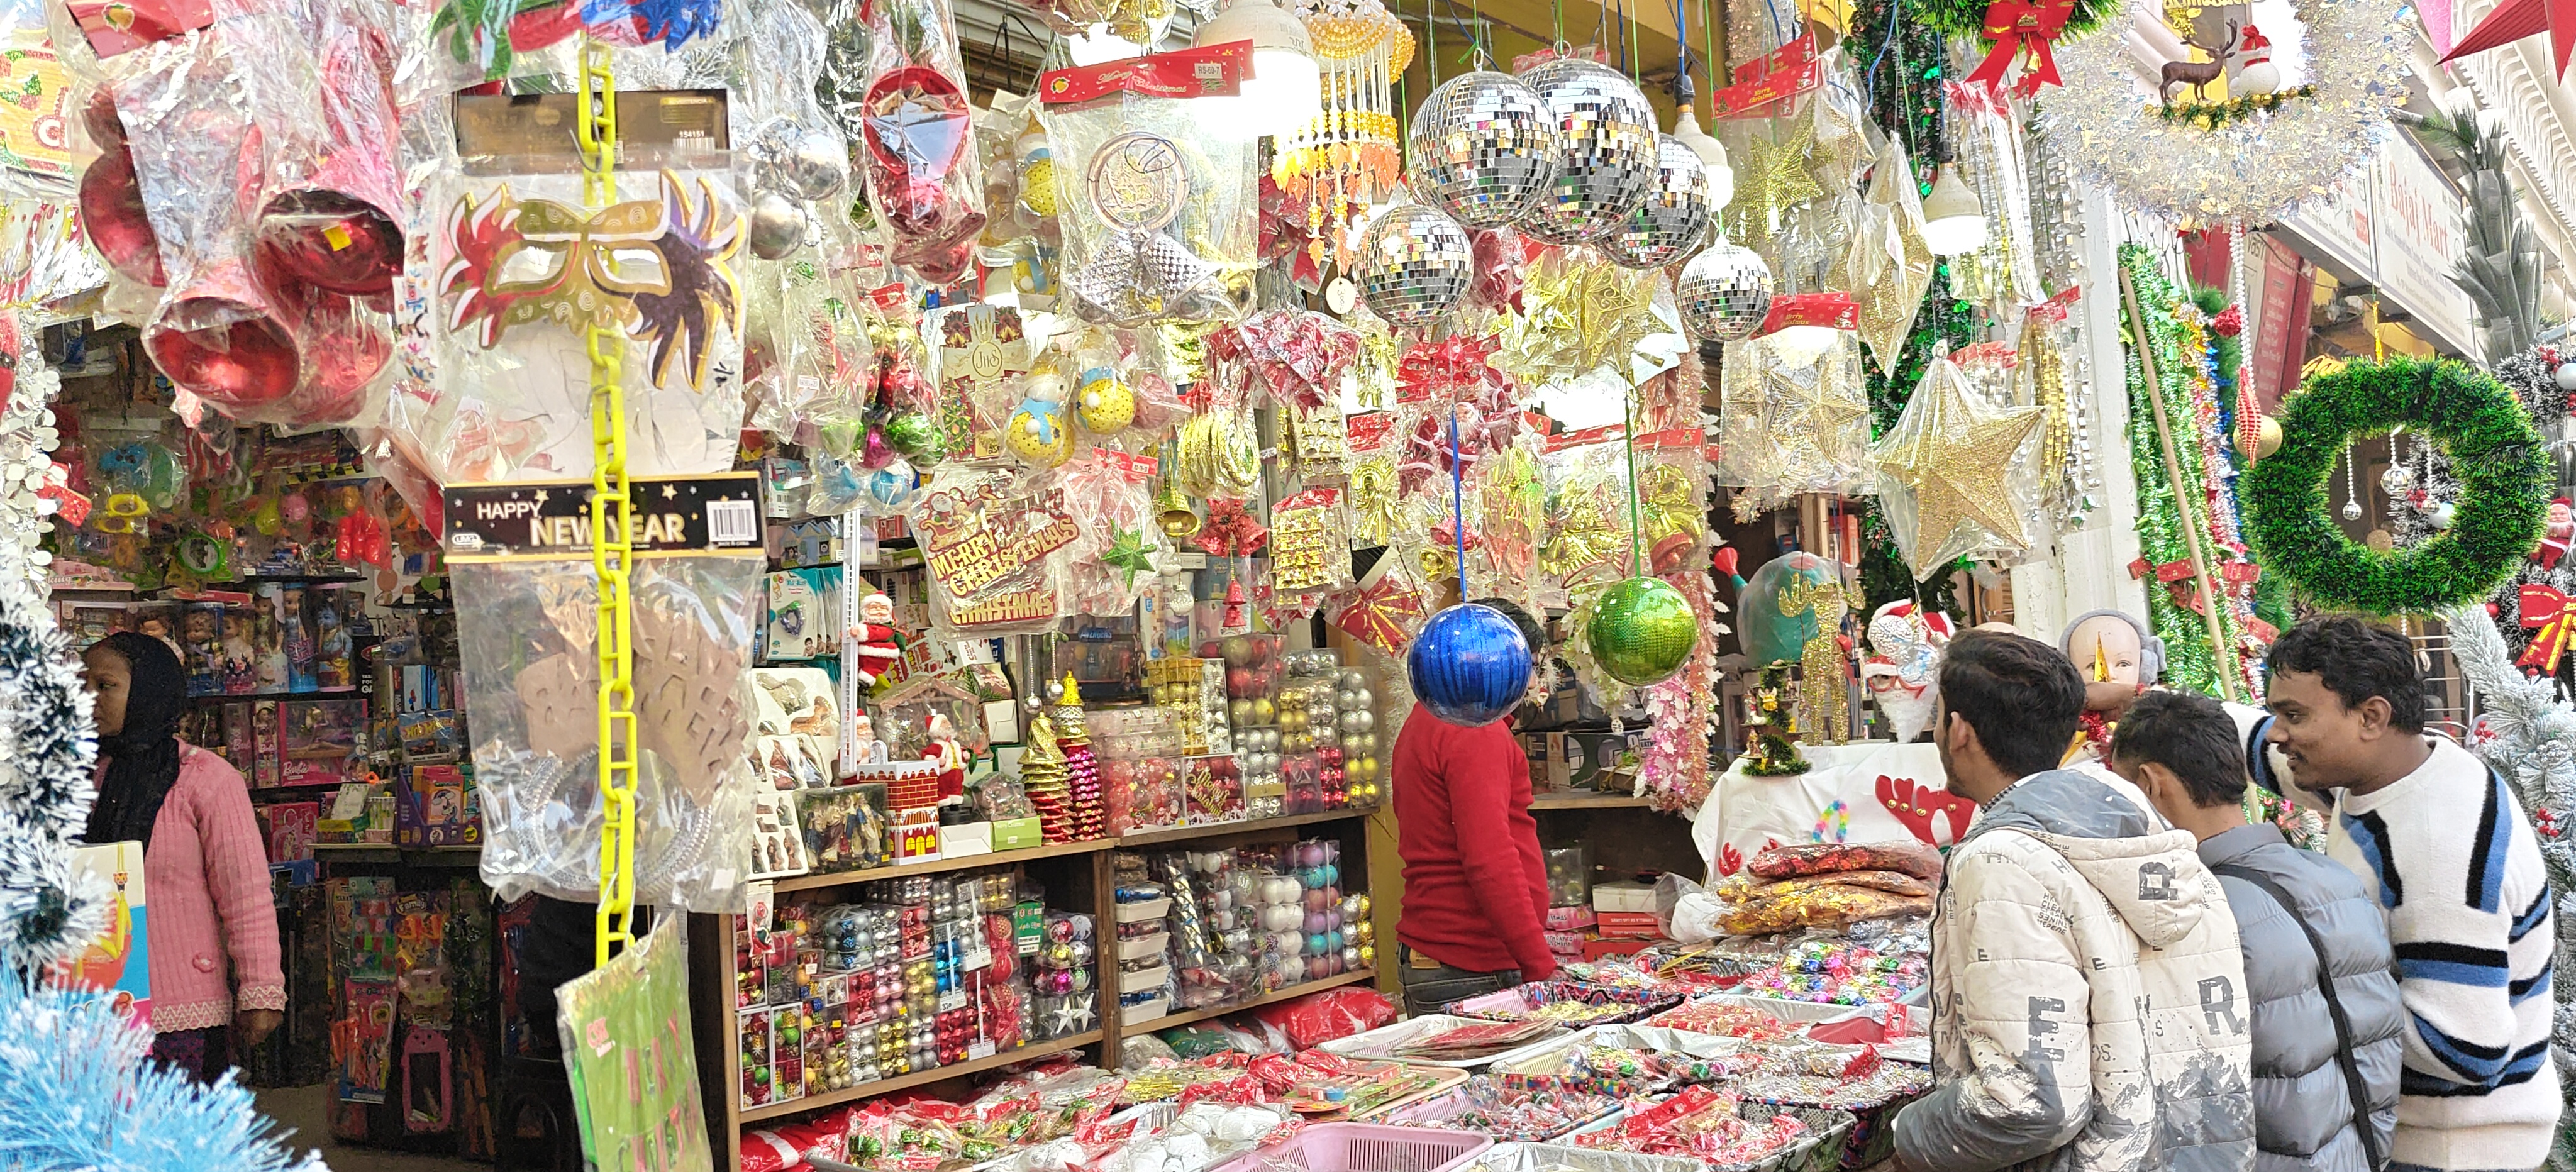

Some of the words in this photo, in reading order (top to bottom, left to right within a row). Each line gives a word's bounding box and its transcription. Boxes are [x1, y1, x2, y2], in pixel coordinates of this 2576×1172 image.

[2390, 160, 2421, 247] Bajaj
[2422, 196, 2450, 262] Mart
[976, 350, 999, 369] JHS
[477, 501, 545, 519] HAPPY
[530, 516, 595, 546] NEW
[606, 513, 686, 546] YEAR
[930, 529, 996, 579] MERRY
[949, 517, 1079, 595] CHRISTMAS
[284, 761, 309, 777] Barbie
[2028, 996, 2065, 1062] E
[2197, 975, 2246, 1036] R
